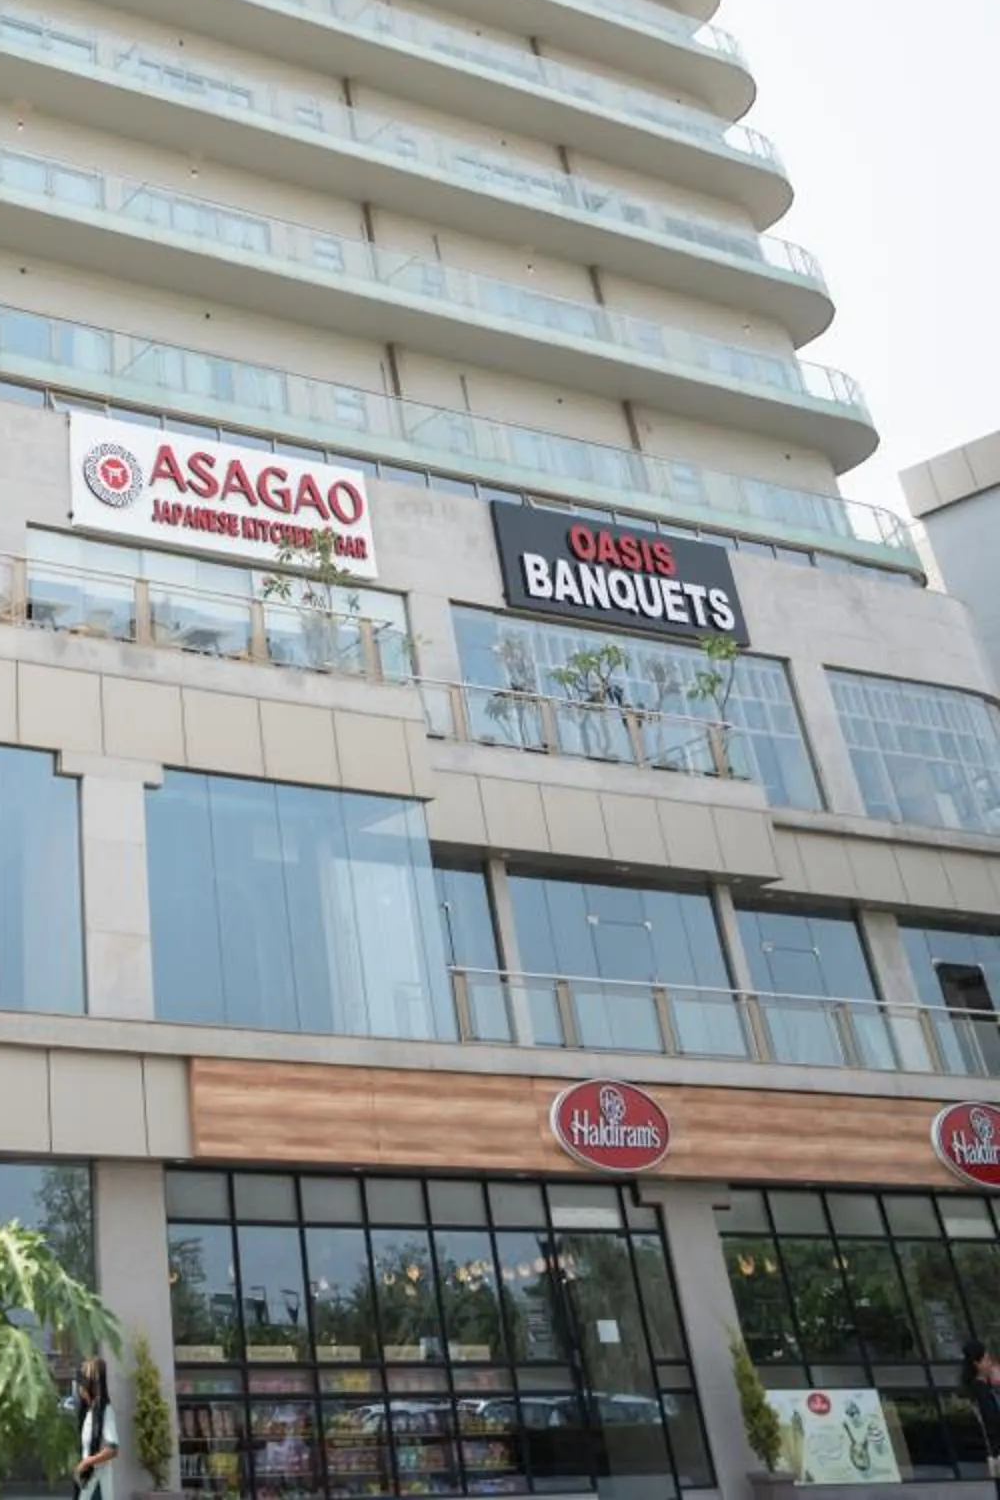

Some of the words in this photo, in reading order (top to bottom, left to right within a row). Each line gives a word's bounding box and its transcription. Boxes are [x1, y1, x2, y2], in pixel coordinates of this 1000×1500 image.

[149, 444, 364, 525] ASAGAO
[151, 498, 240, 537] JAPANESE
[567, 523, 677, 577] OASIS
[521, 551, 736, 631] BANQUETS
[570, 1108, 661, 1149] Haldiram's
